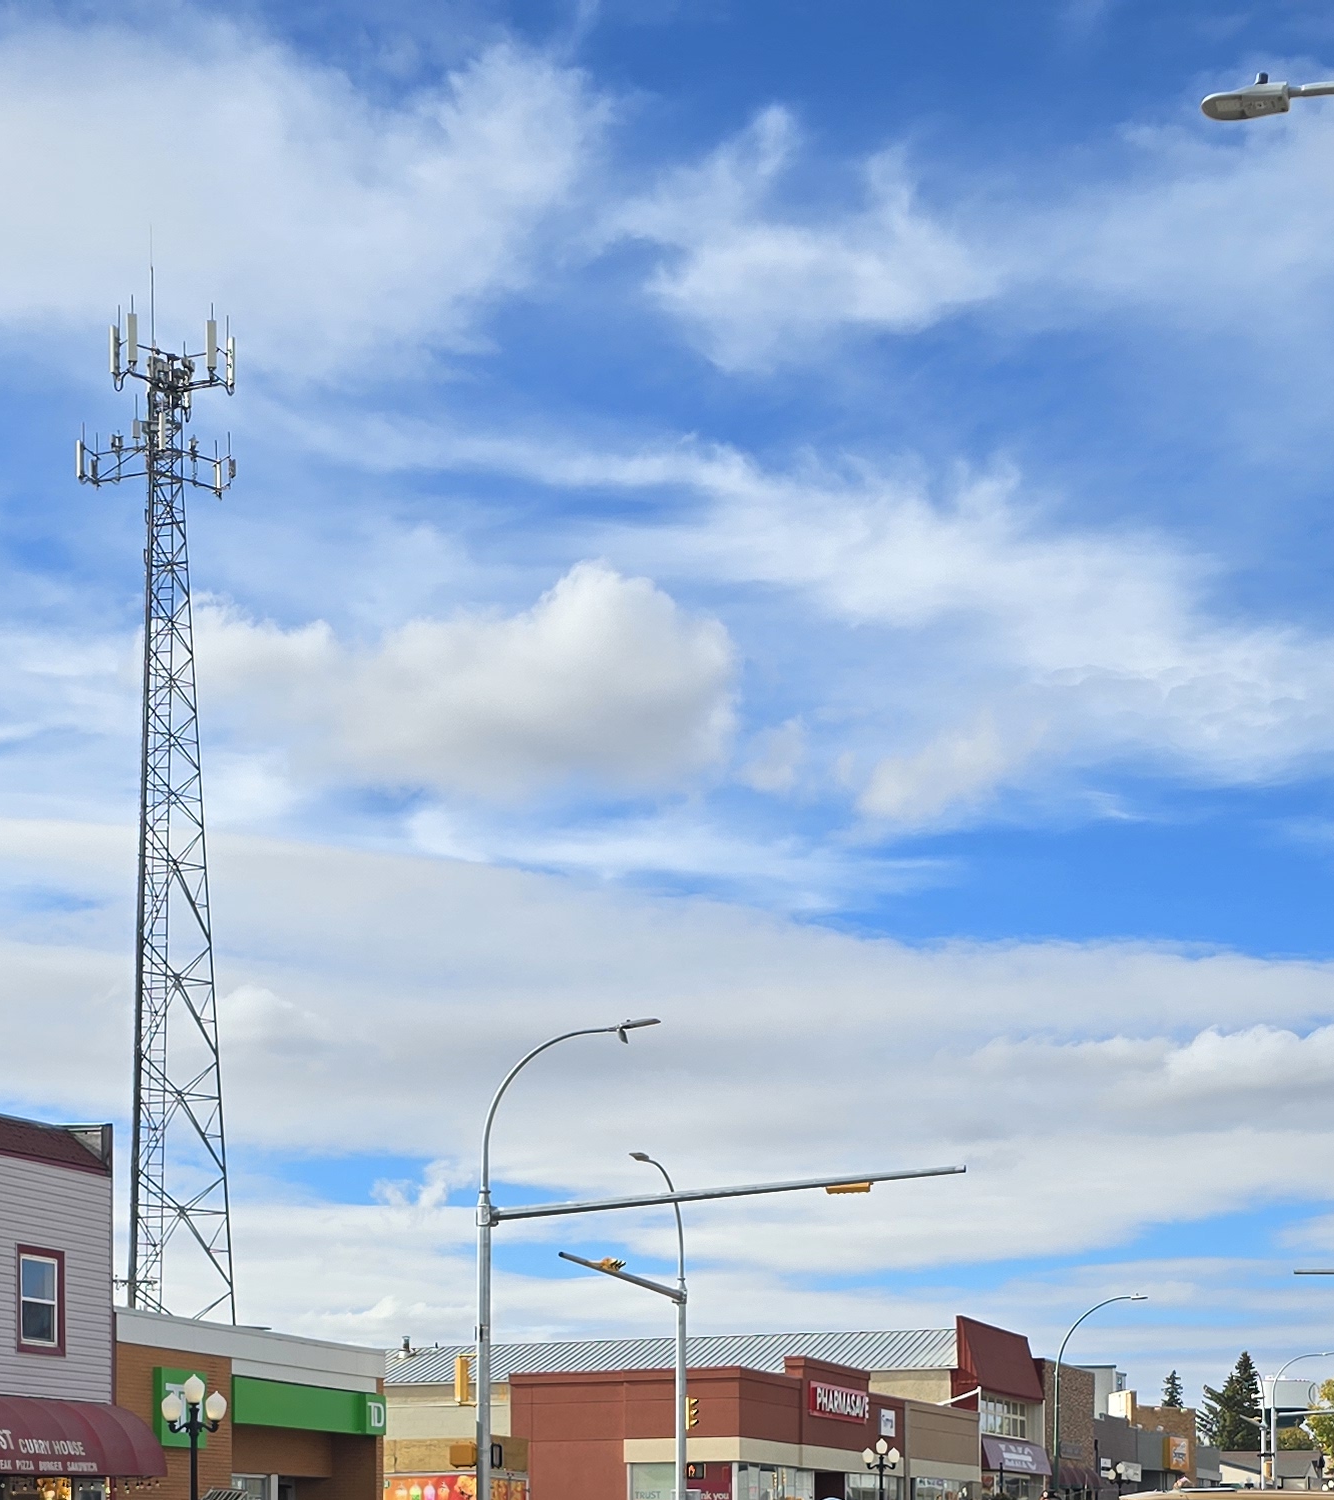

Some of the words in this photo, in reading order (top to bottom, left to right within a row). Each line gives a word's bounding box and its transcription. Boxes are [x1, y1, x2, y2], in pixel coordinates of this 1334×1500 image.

[816, 1387, 869, 1419] PHARMASAVE
[367, 1402, 385, 1427] TD
[18, 1438, 52, 1455] CURRY
[52, 1440, 86, 1456] HOUSE
[16, 1460, 35, 1471] PIZZA
[39, 1461, 63, 1472] BURGER
[635, 1490, 661, 1499] TRUST
